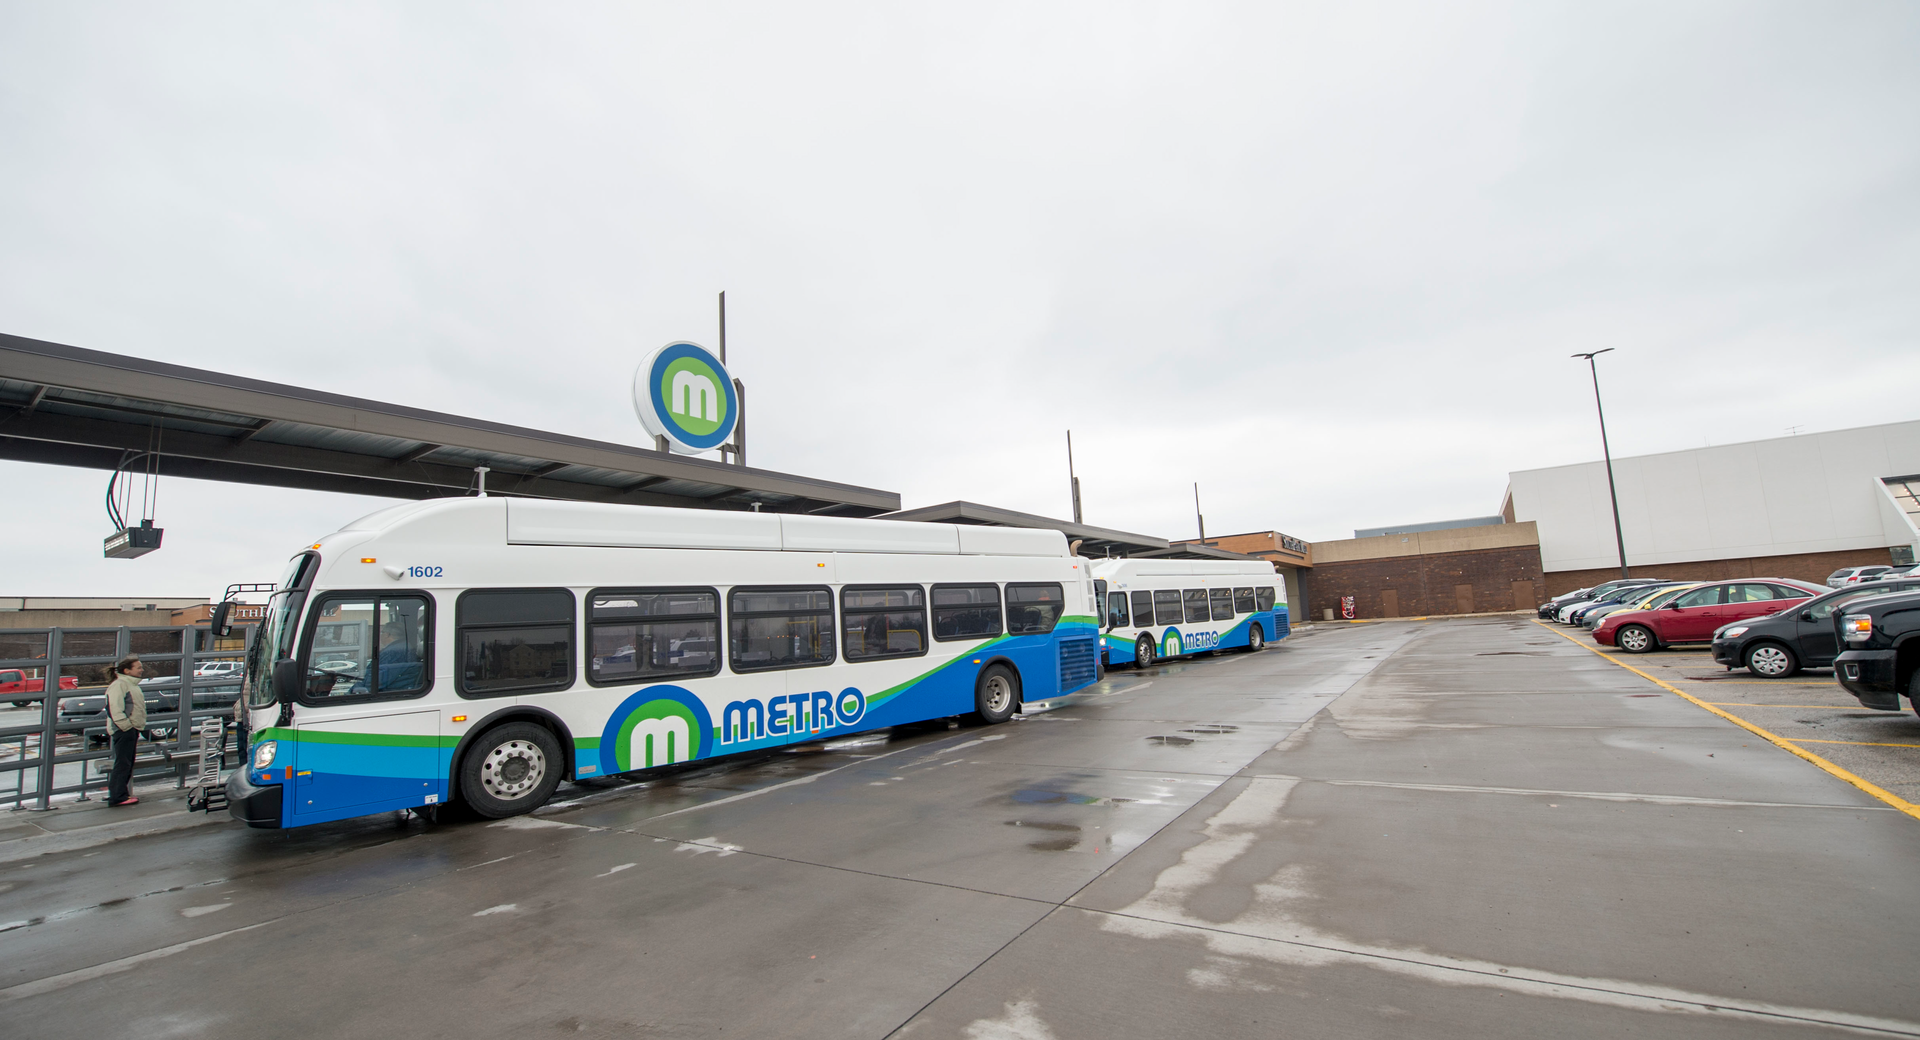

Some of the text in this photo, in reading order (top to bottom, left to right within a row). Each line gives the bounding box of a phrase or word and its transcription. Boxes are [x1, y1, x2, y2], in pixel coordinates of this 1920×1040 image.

[672, 370, 718, 423] m
[407, 566, 443, 578] 1602
[208, 606, 267, 618] STH
[1185, 630, 1219, 650] METRO
[721, 686, 867, 745] METRO
[630, 715, 689, 771] m
